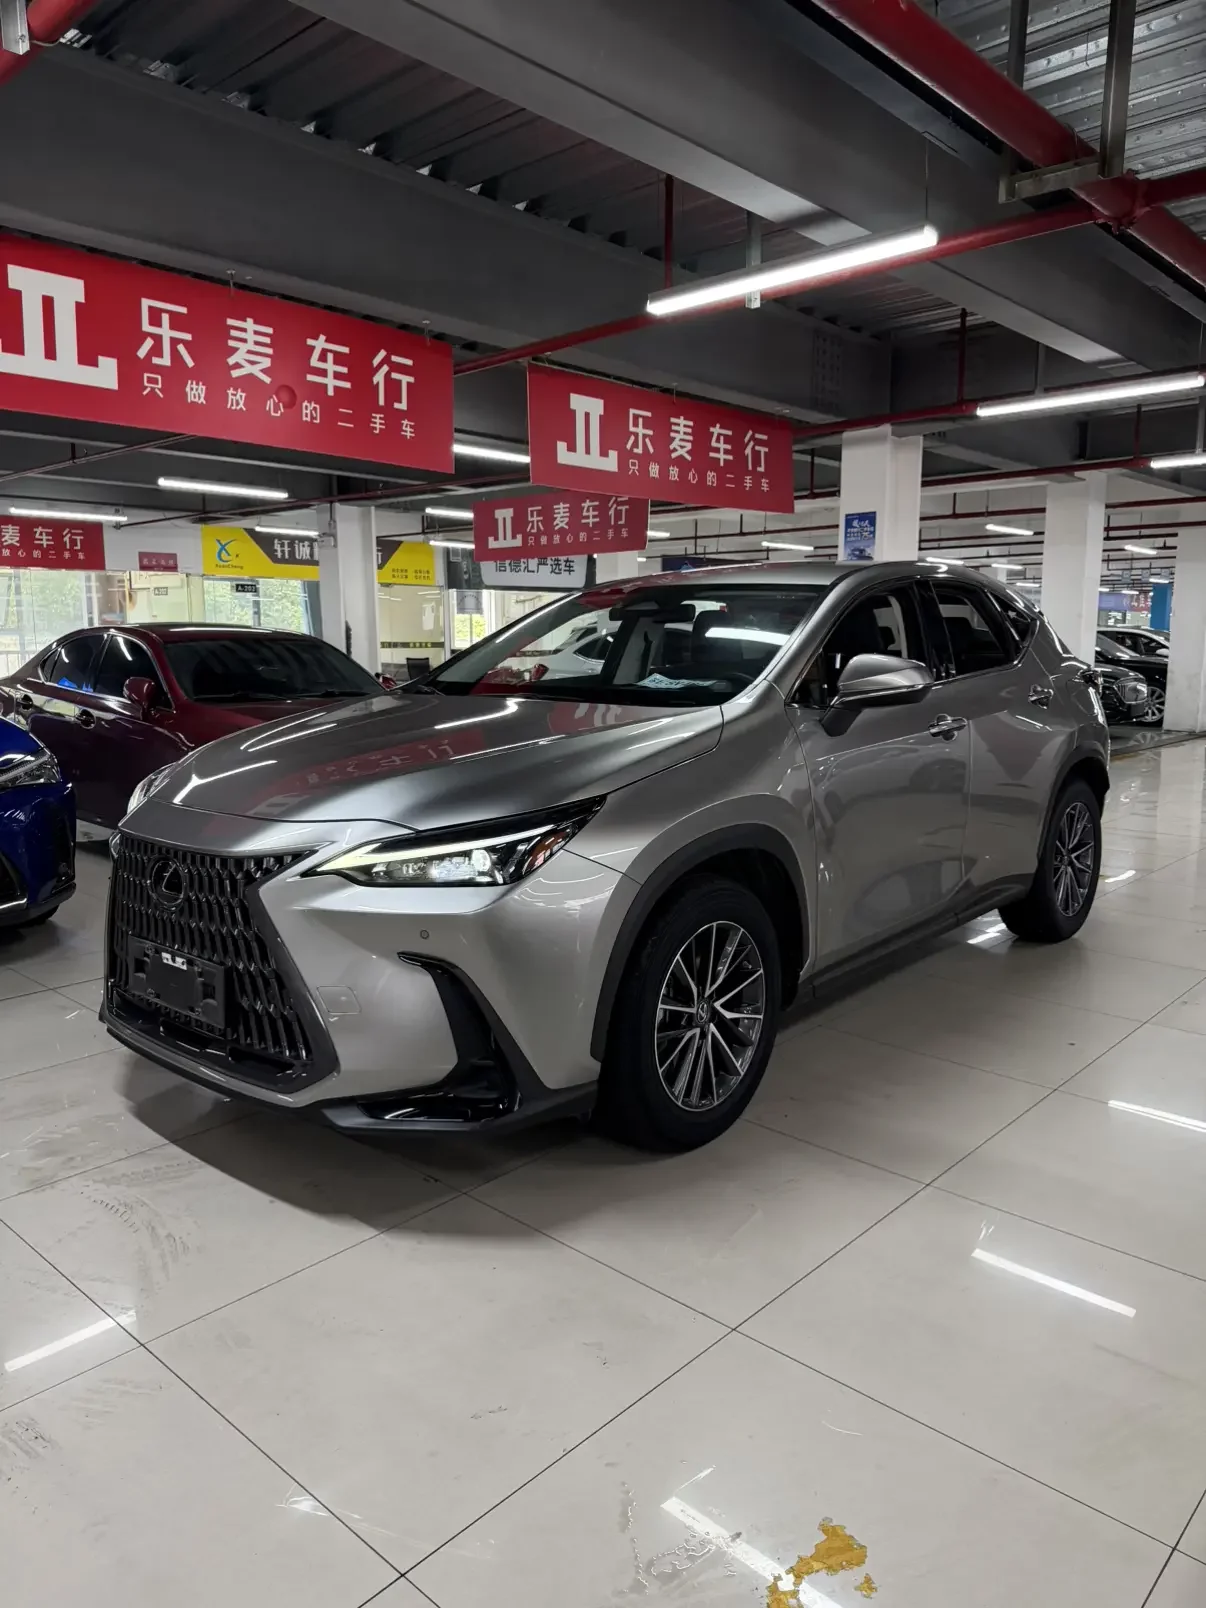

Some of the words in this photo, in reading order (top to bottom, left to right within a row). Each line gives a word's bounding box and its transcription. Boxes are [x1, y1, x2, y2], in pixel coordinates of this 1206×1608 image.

[137, 297, 415, 411] 乐麦车行
[142, 373, 416, 439] 只做放心的二手车
[626, 408, 769, 472] 乐麦车行
[628, 459, 770, 492] 只做放心的二手车
[526, 497, 629, 533] 乐麦车行
[0, 524, 84, 549] 麦车行
[528, 527, 629, 546] 只做放心的二手车
[494, 557, 575, 576] 信德汇严选车
